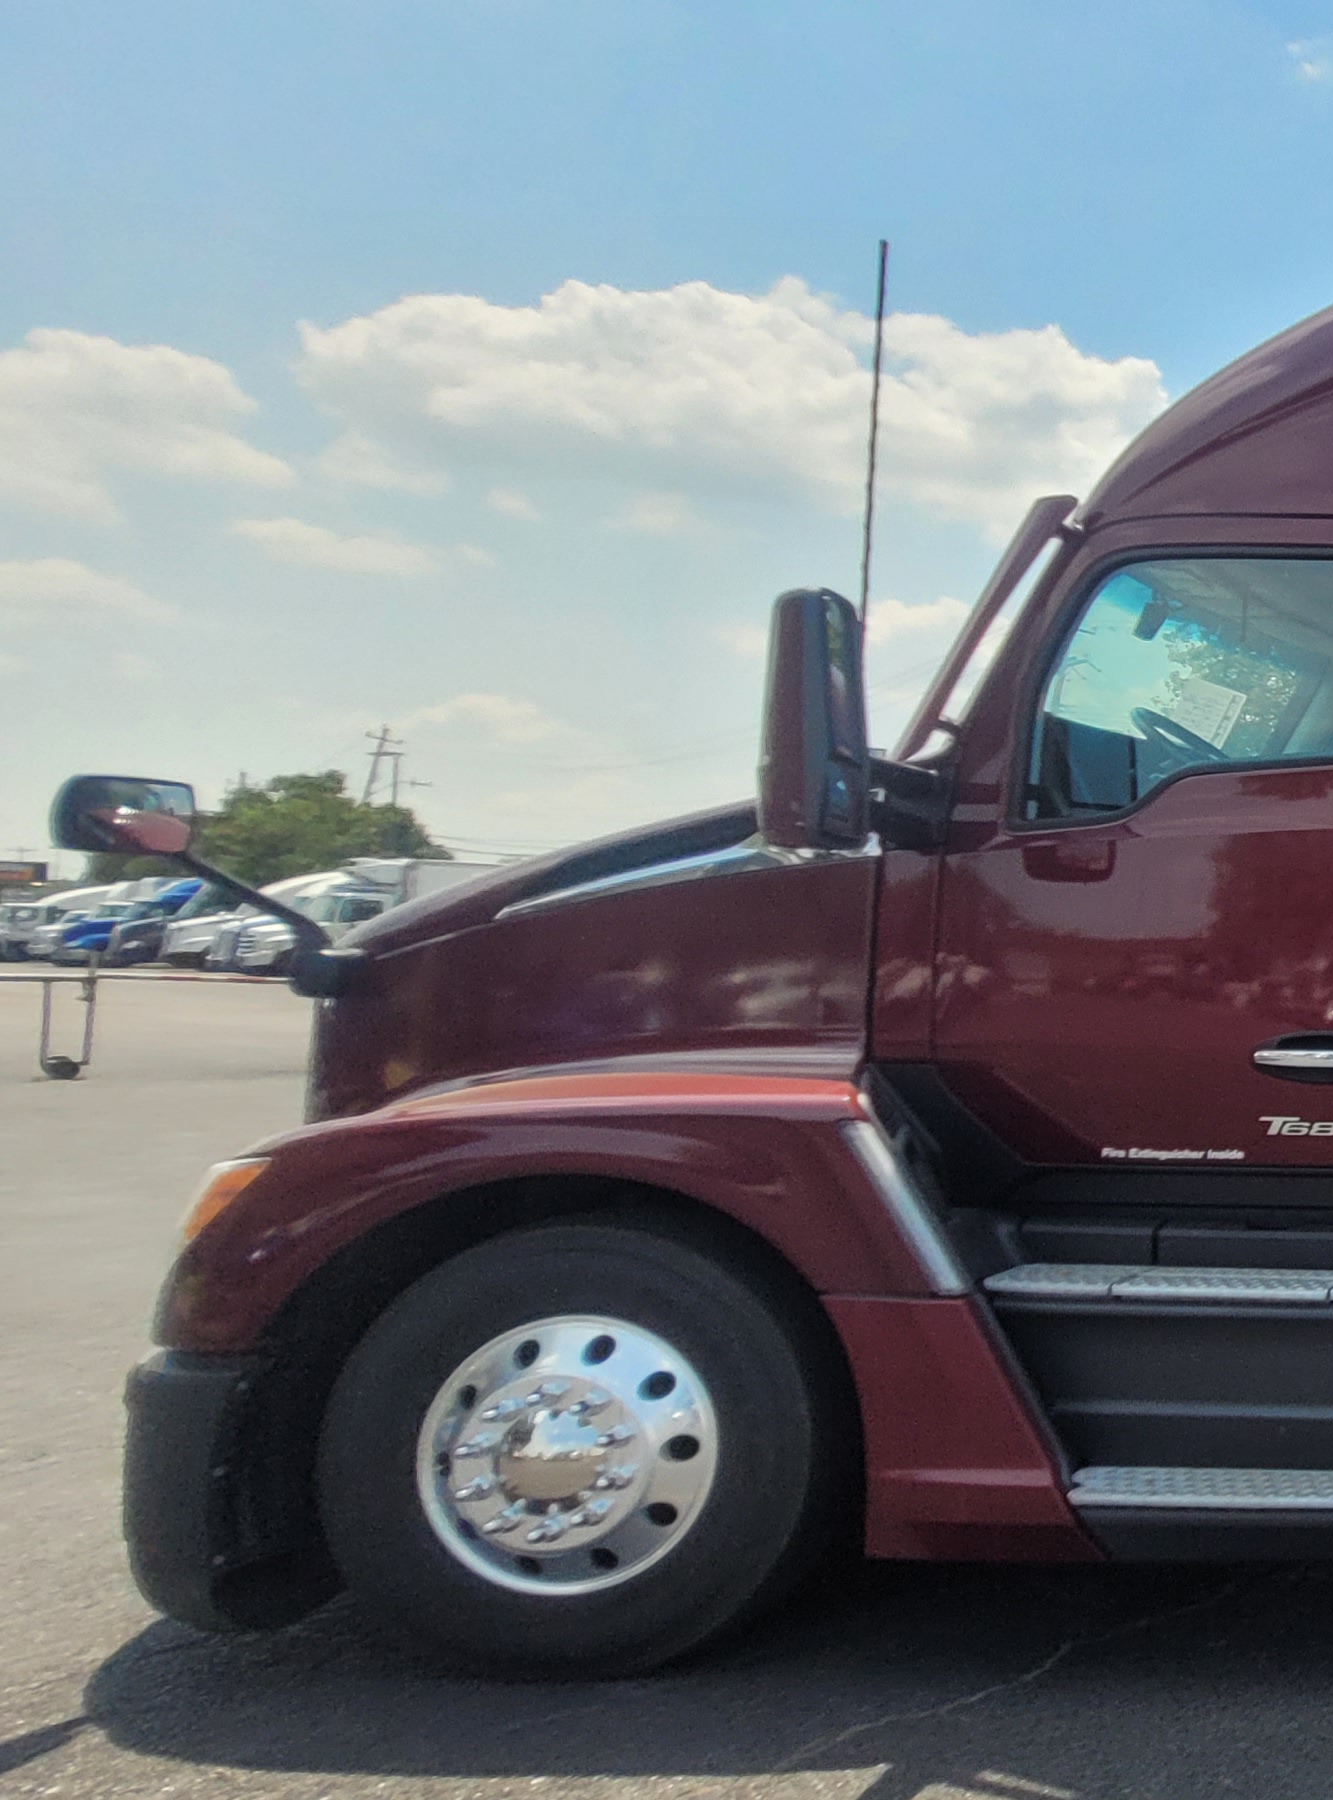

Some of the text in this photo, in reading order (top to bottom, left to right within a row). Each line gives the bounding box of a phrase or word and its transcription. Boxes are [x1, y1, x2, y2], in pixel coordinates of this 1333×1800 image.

[1101, 1147, 1245, 1160] Fire Extinguisher Inside
